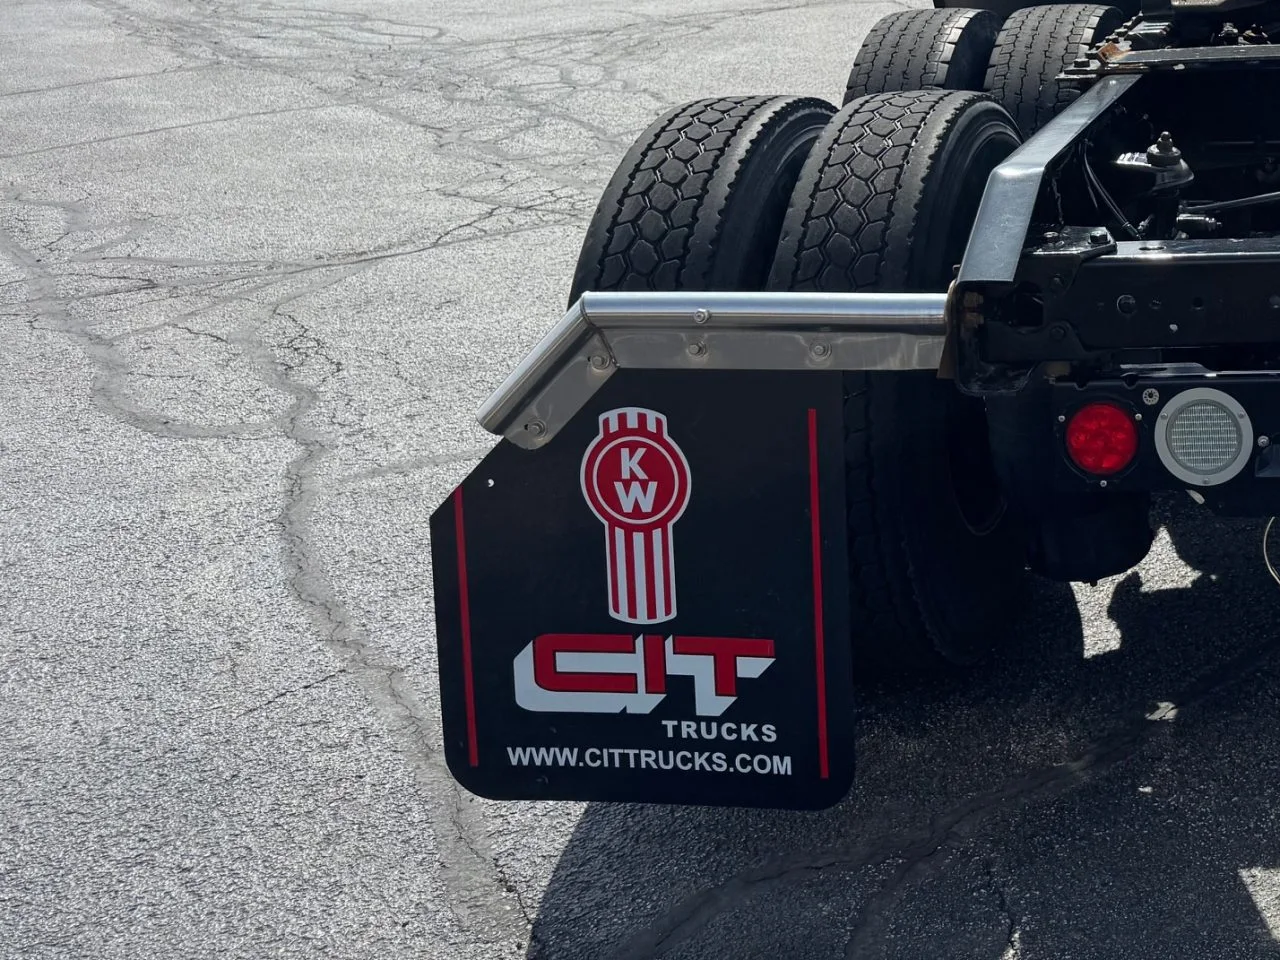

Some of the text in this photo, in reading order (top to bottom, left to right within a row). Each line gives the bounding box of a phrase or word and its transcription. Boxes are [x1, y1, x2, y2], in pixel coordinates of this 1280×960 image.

[513, 633, 777, 717] CIT
[662, 720, 778, 743] TRUCKS
[507, 747, 793, 776] WWW.CITTRUCKS.COM
